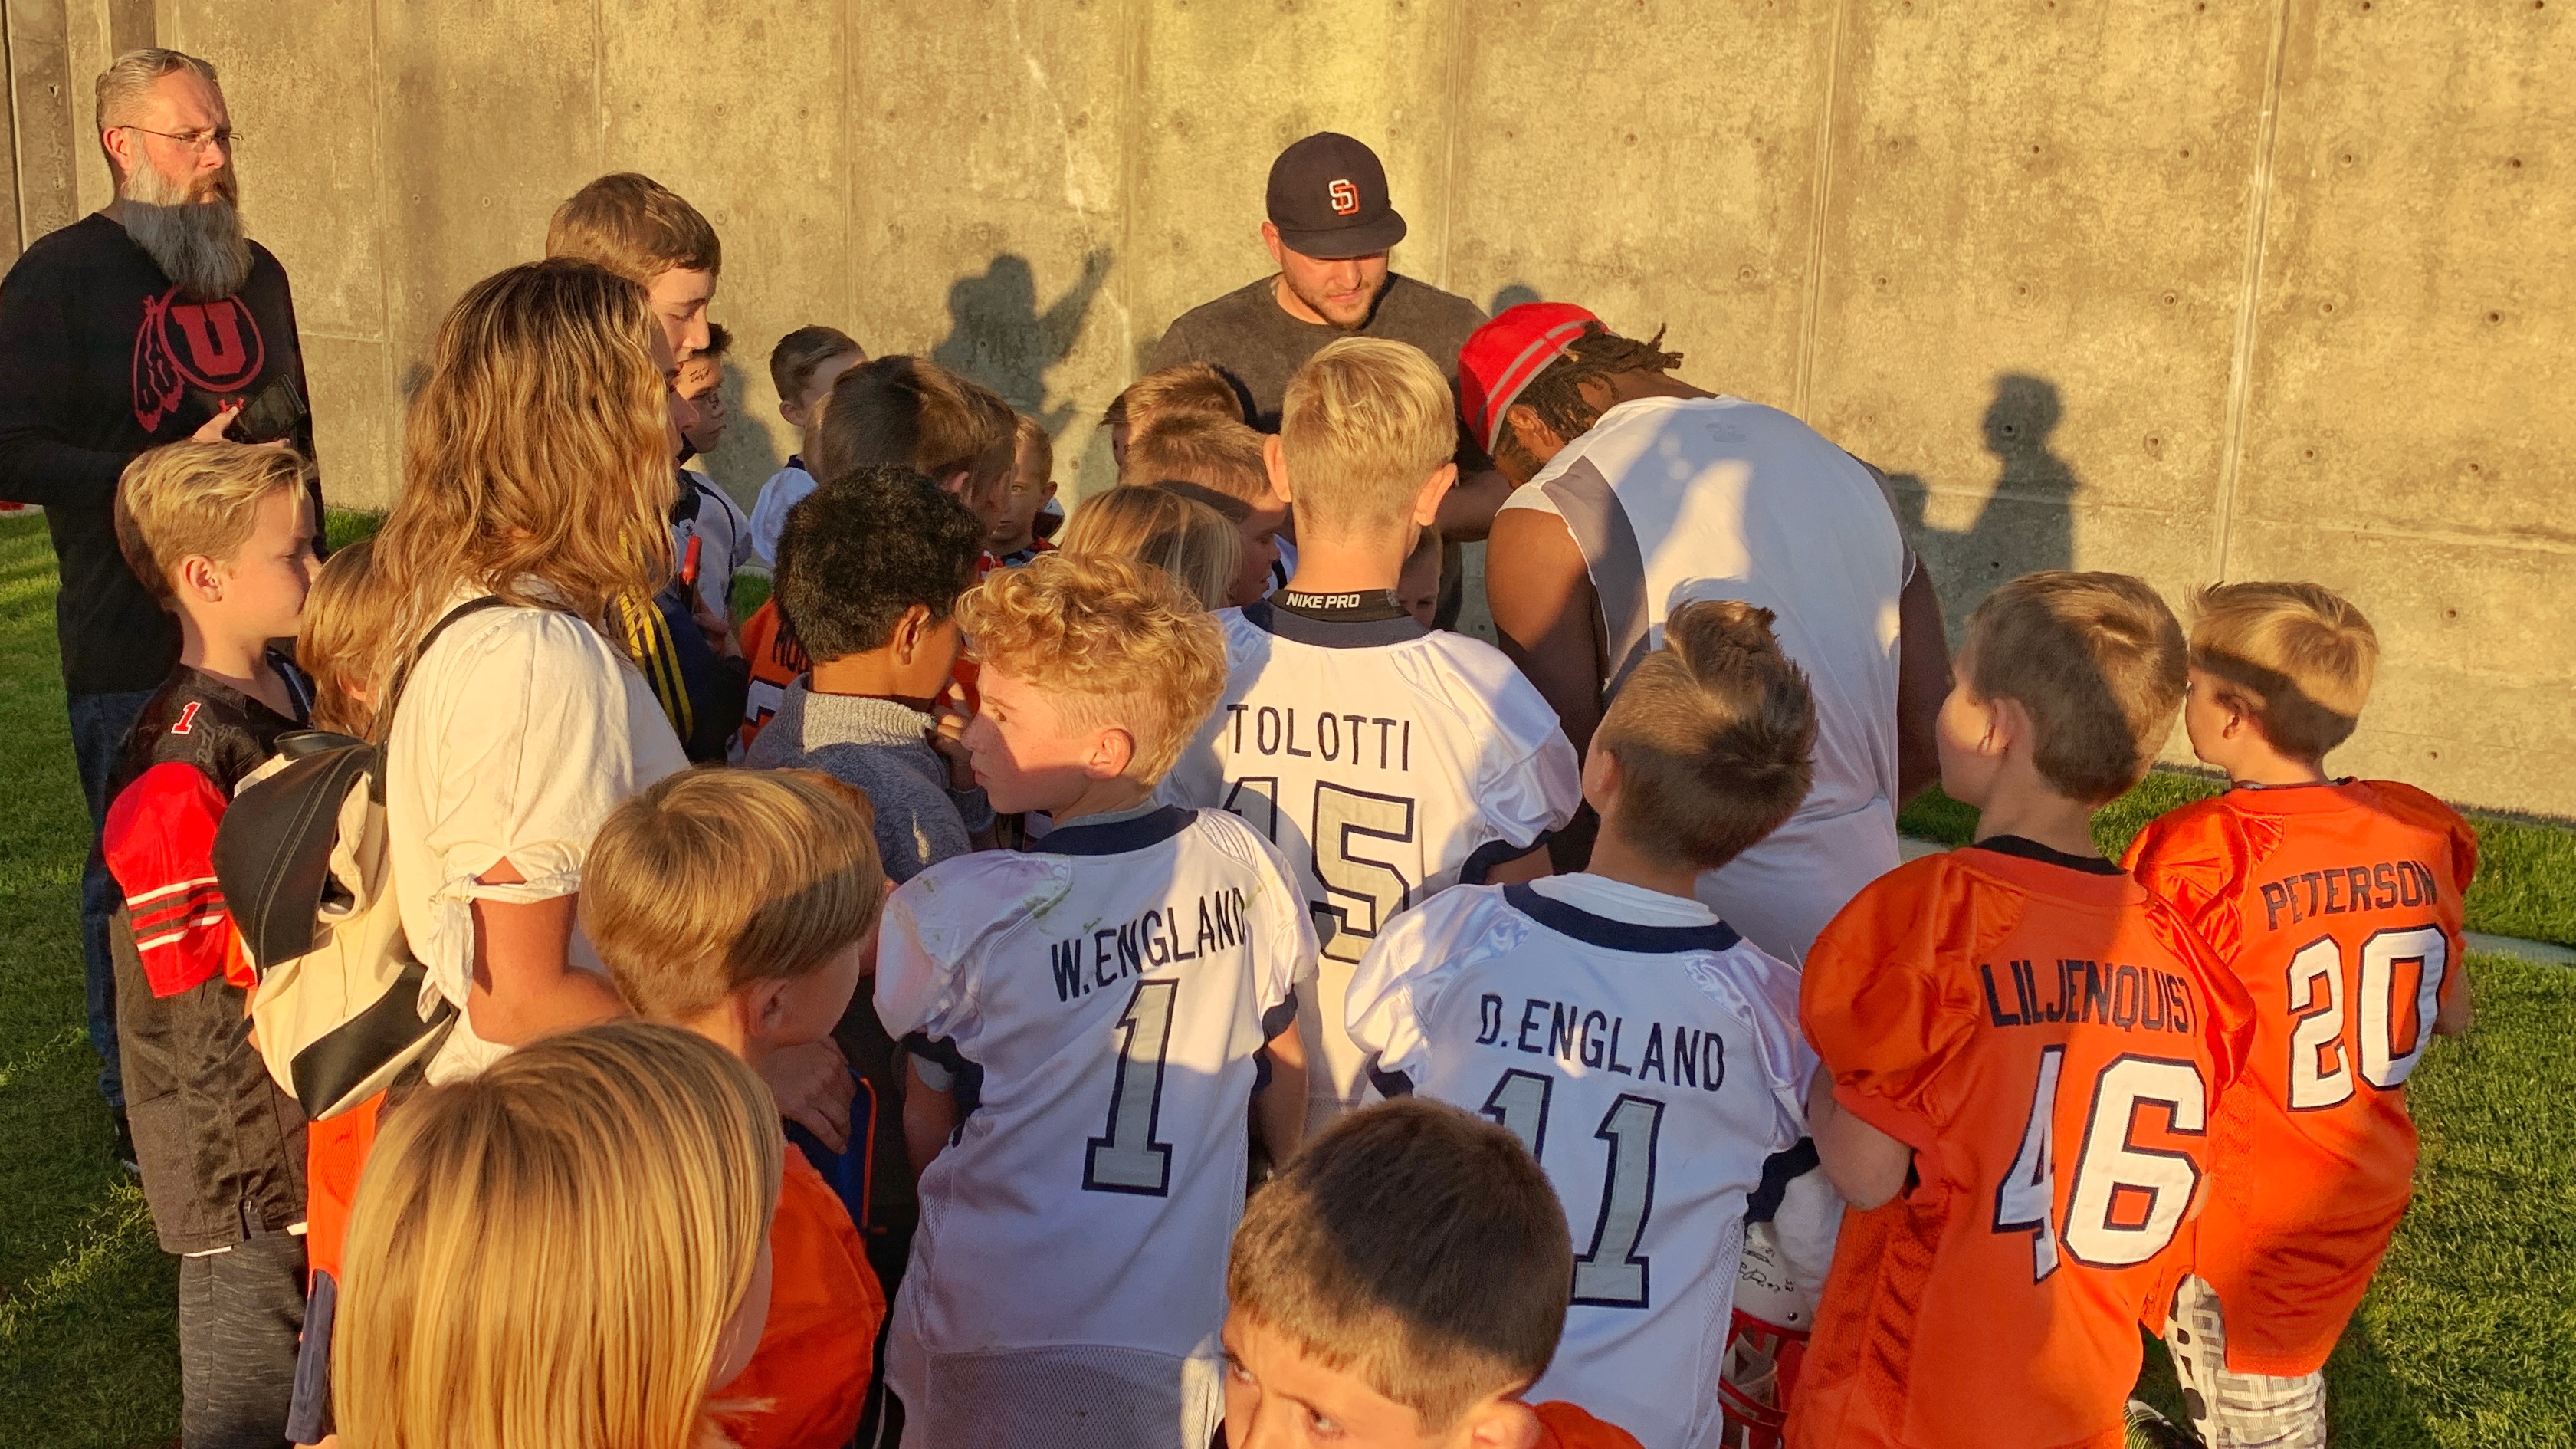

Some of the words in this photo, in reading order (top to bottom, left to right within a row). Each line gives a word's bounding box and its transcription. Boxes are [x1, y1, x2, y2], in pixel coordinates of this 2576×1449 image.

[171, 301, 248, 377] U
[1285, 593, 1324, 609] NIKE
[1324, 594, 1360, 609] PRO
[171, 701, 202, 734] 1
[1226, 703, 1410, 771] TOLOTTI
[2259, 859, 2438, 931] PETERSON
[1051, 886, 1245, 1002] W.ENGLAND
[1476, 994, 1725, 1092] D.ENGLAND
[2286, 922, 2449, 1112] 20
[1081, 978, 1180, 1198] 1
[1991, 1043, 2207, 1286] 46
